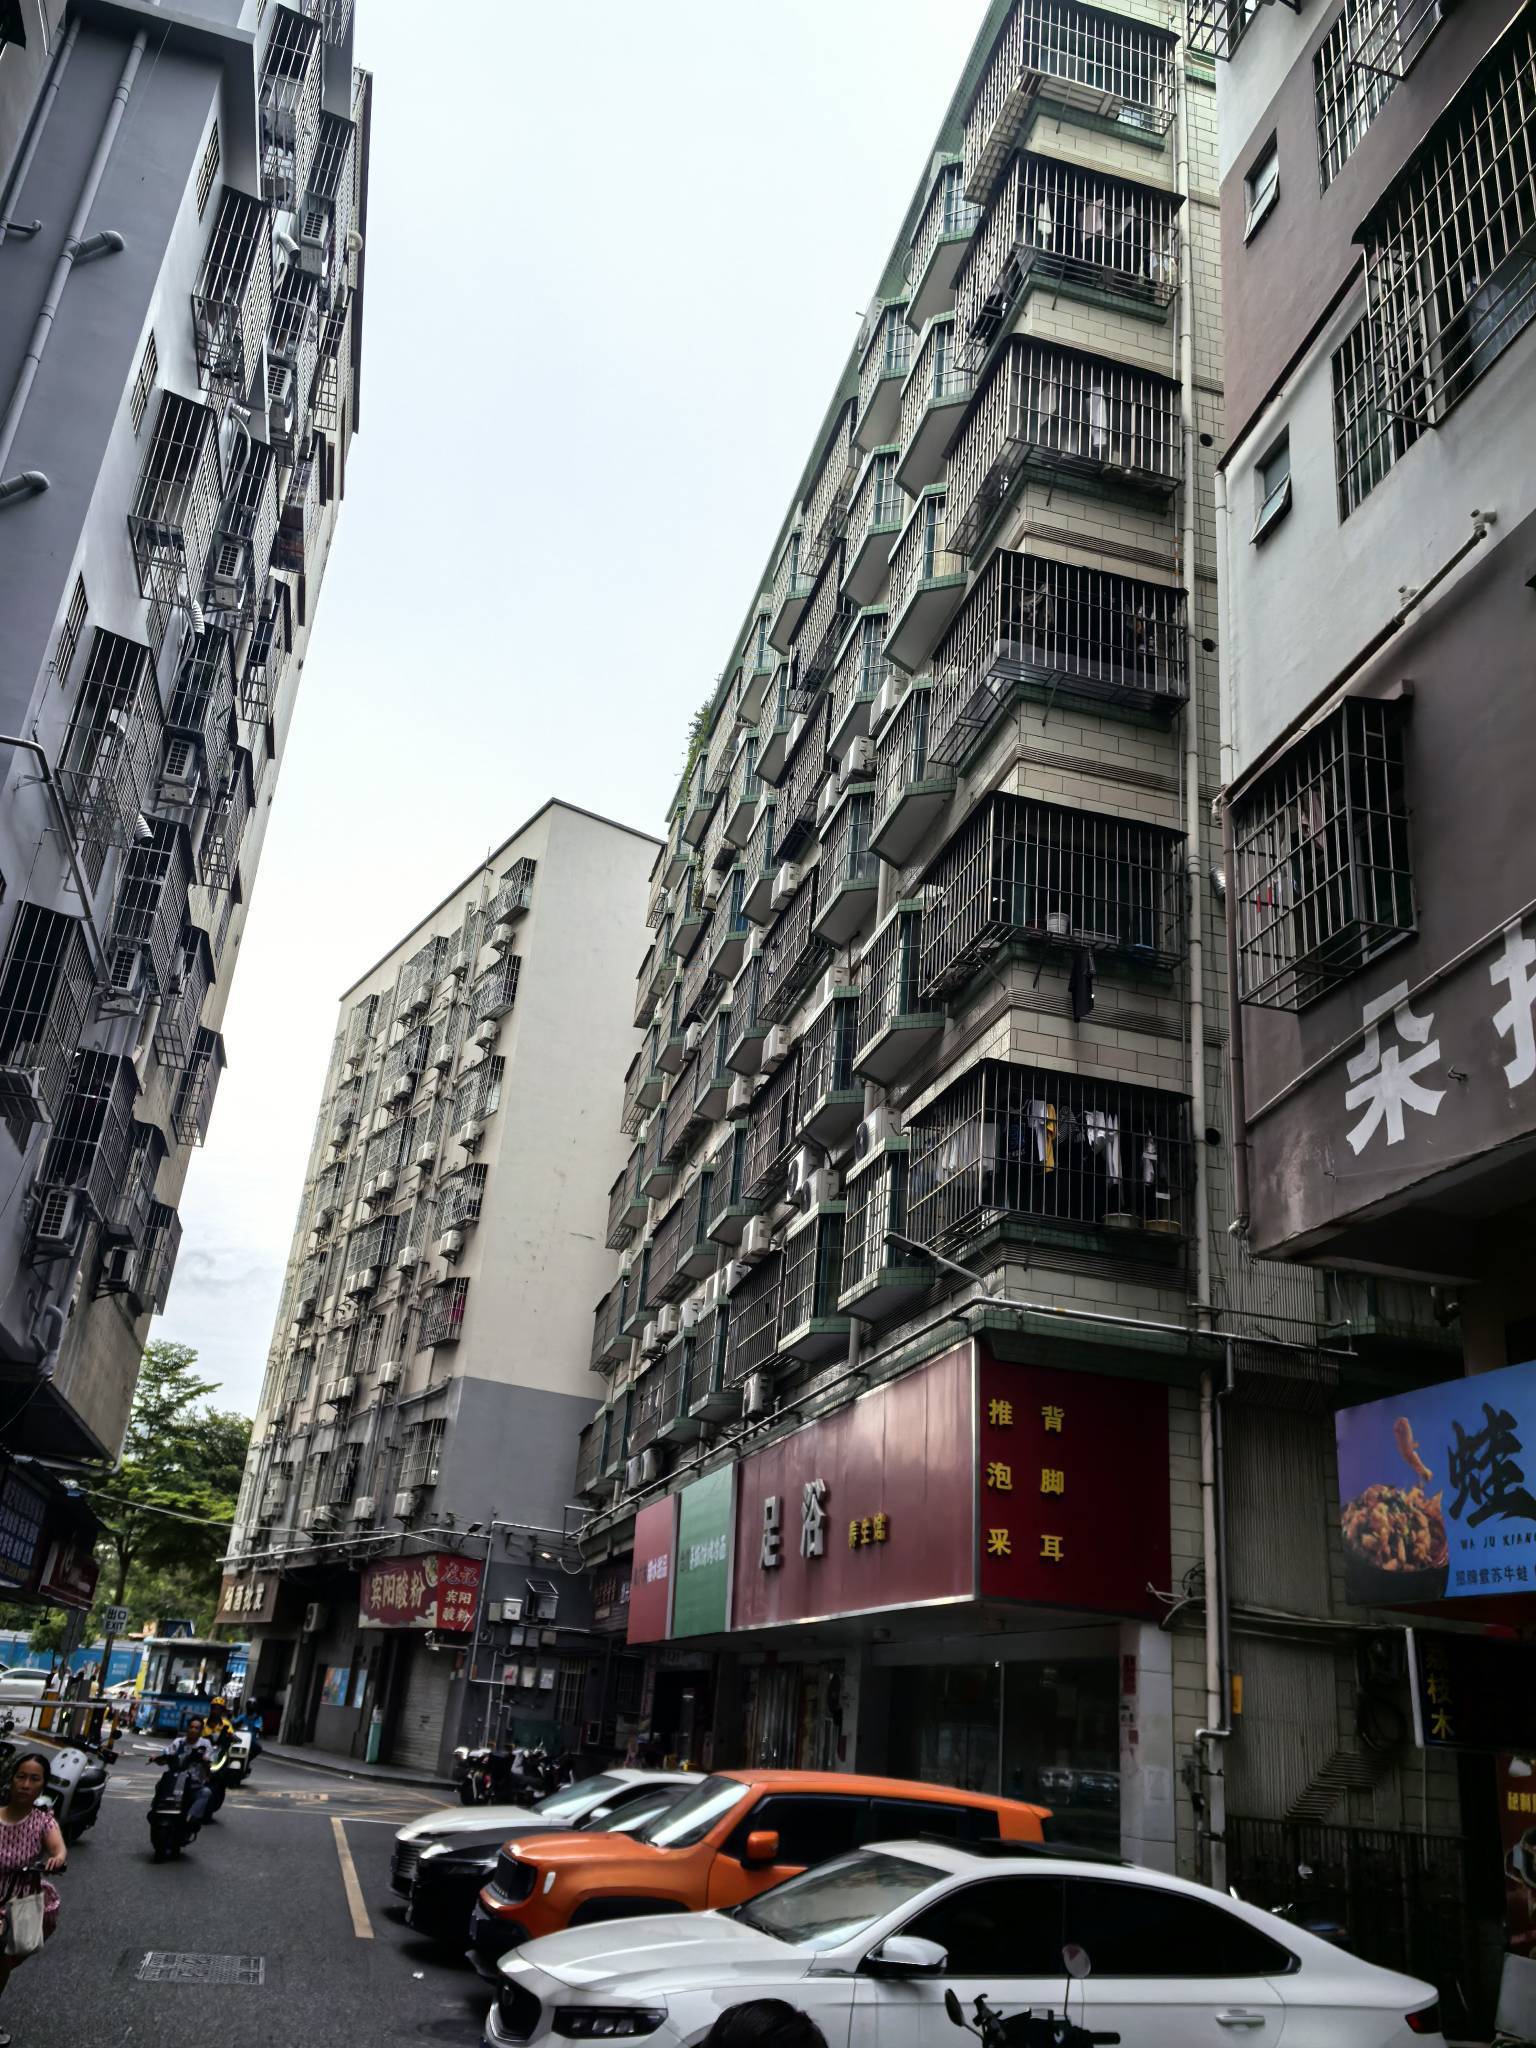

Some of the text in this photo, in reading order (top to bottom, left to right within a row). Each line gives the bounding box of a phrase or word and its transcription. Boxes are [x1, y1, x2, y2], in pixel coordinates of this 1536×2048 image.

[988, 1398, 1065, 1433] 推背
[987, 1462, 1065, 1496] 泡脚
[1447, 1402, 1536, 1528] 蛙
[759, 1478, 827, 1569] 足浴
[848, 1511, 889, 1551] 养生馆
[1503, 1531, 1536, 1547] XIAN
[987, 1528, 1065, 1562] 采耳
[370, 1570, 426, 1610] 宾阳酸粉
[445, 1589, 472, 1605] 宾阳
[105, 1621, 125, 1631] EXIT
[107, 1608, 127, 1620] 出口
[442, 1606, 472, 1623] 酸粉
